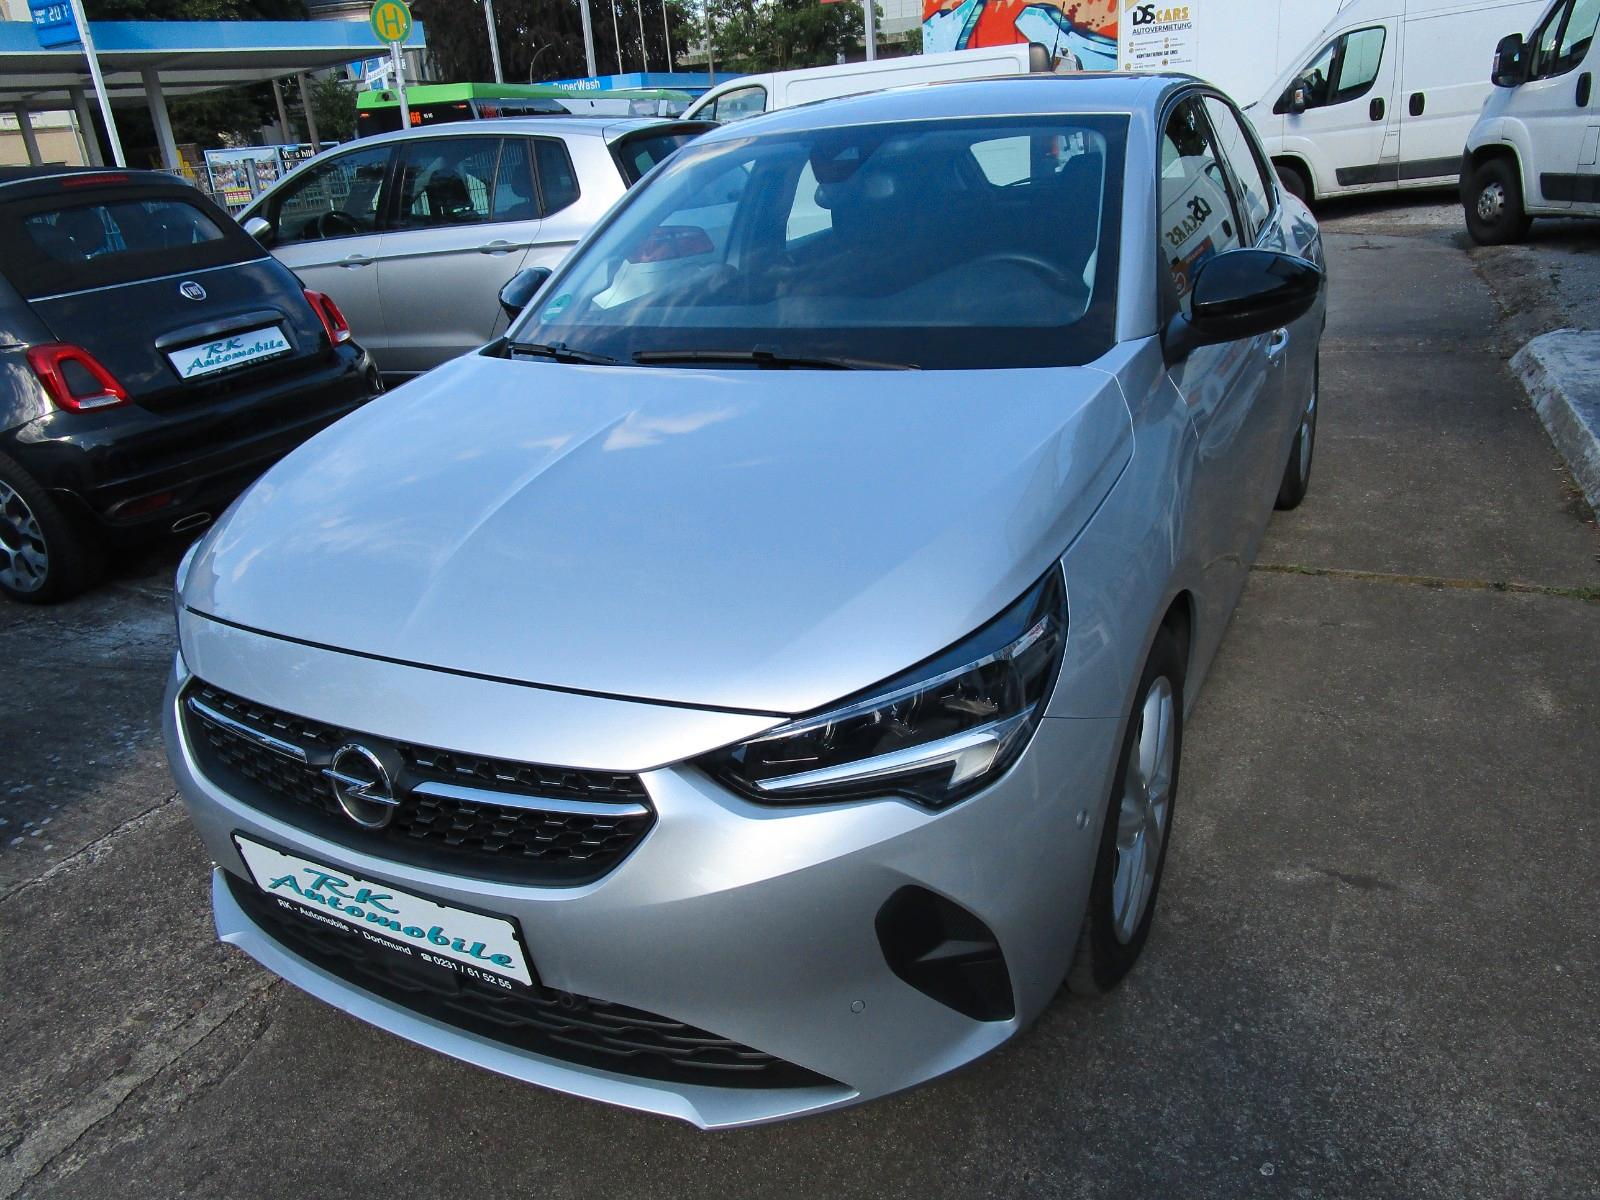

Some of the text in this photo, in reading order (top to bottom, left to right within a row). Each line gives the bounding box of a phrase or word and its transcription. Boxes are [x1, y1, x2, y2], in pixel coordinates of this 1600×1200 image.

[381, 6, 401, 36] H
[1132, 22, 1192, 36] AUTOVERMIETUNG
[186, 339, 284, 375] Automobile
[202, 338, 244, 359] RK
[303, 868, 400, 914] RK
[268, 874, 516, 968] Automobile
[277, 899, 292, 910] RK
[300, 906, 350, 932] Automobile
[362, 931, 412, 955] Dortmund
[433, 956, 458, 971] 0231
[467, 967, 480, 978] 61
[482, 972, 497, 984] 52
[498, 977, 512, 990] 55
